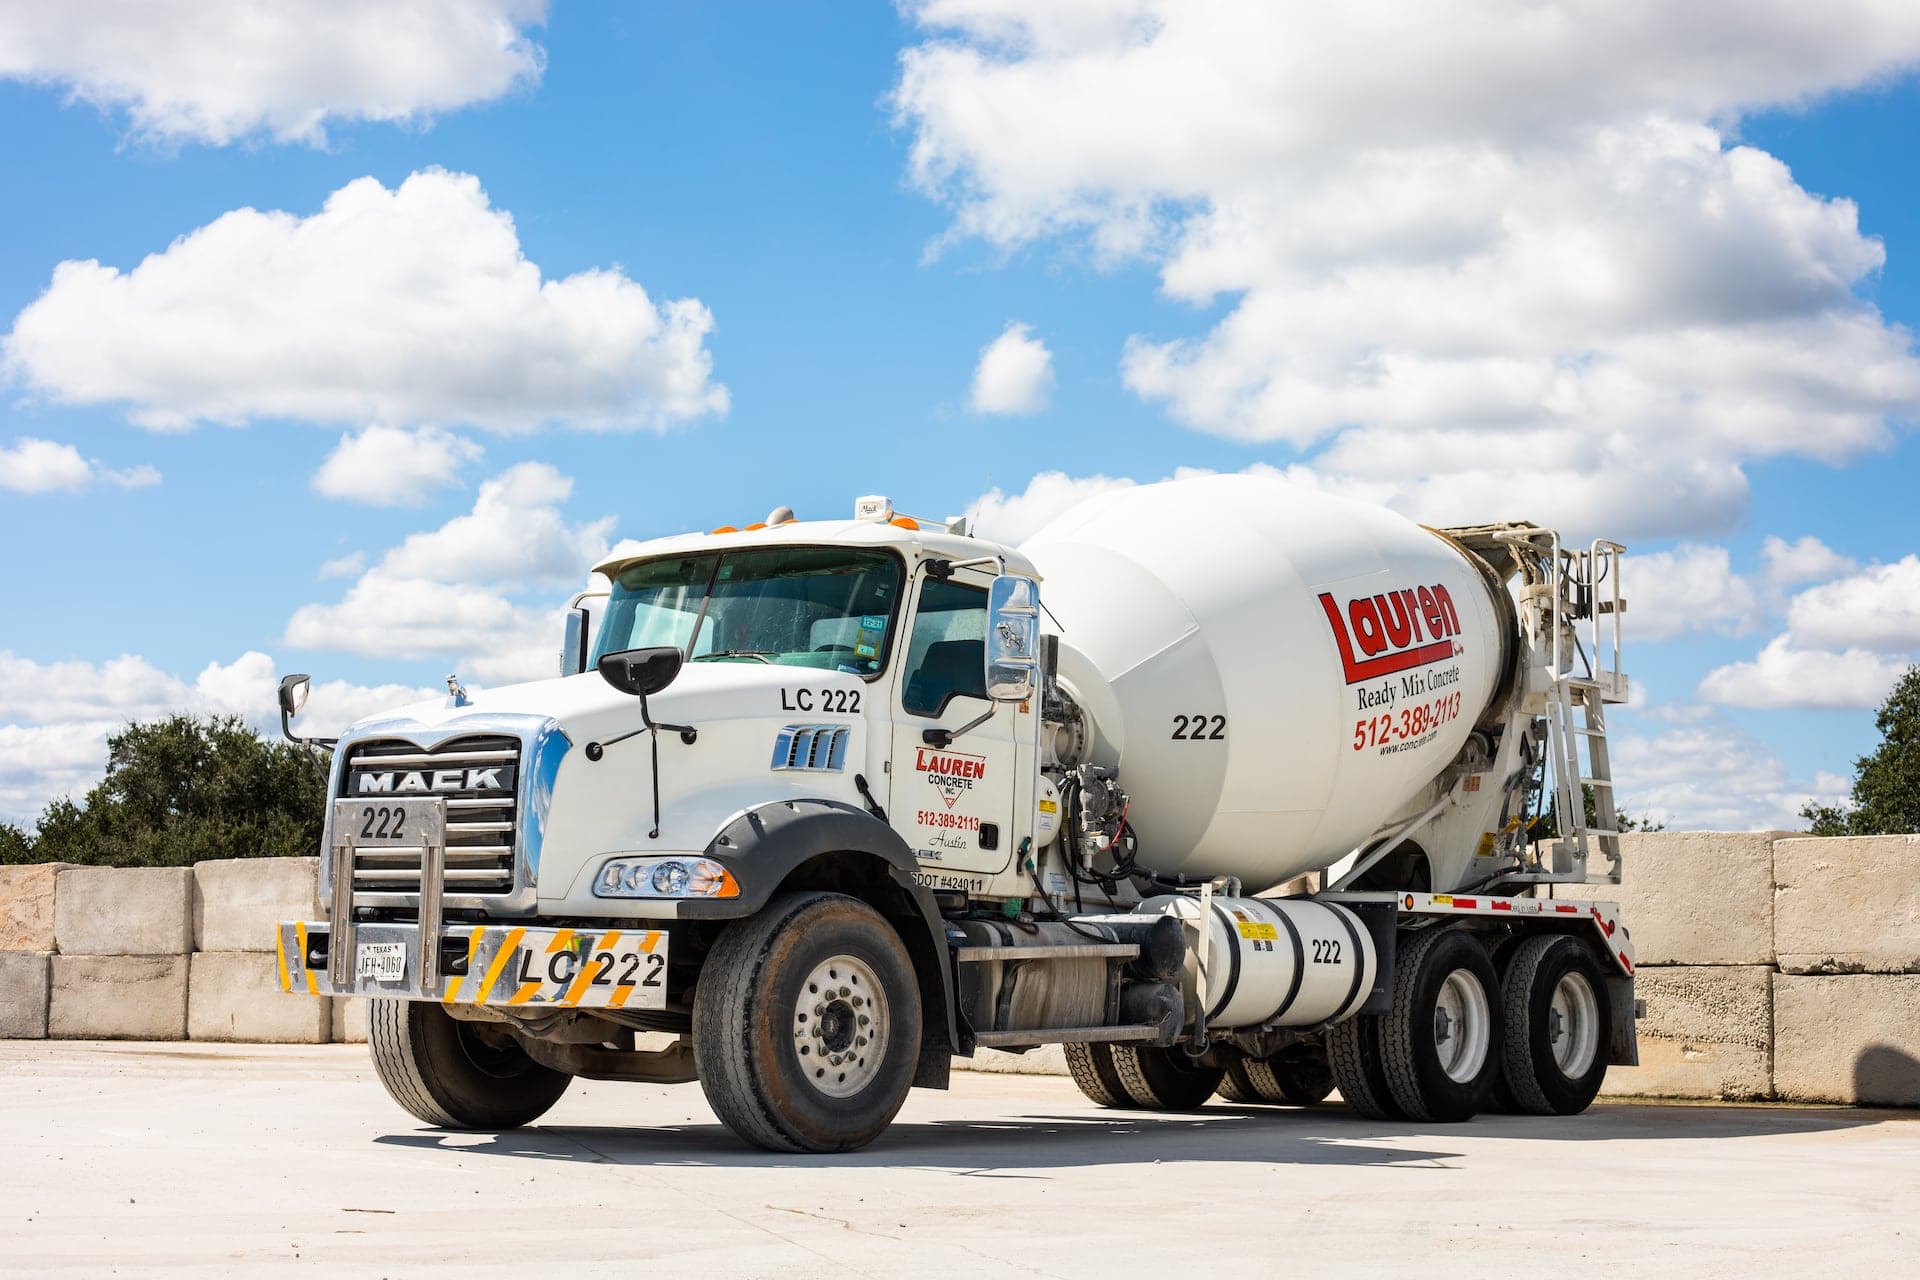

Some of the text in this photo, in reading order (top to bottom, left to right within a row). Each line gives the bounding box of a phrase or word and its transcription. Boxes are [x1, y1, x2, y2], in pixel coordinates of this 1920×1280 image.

[1318, 583, 1461, 686] Lauren
[1357, 664, 1460, 711] Ready Mix Concrete
[781, 688, 860, 713] LC 222
[1171, 714, 1226, 740] 222
[1353, 690, 1461, 751] 512-389-2113
[916, 749, 985, 779] LAUREN
[358, 768, 503, 793] MACK
[928, 774, 973, 789] CONCRETE
[945, 787, 956, 795] INC.
[360, 806, 406, 839] 222
[917, 811, 980, 831] 512-389-2113
[929, 830, 967, 849] Austin
[911, 872, 982, 891] SDOT #424011
[373, 946, 392, 954] TEXAS
[1312, 939, 1342, 964] 222
[519, 949, 665, 986] LC 222
